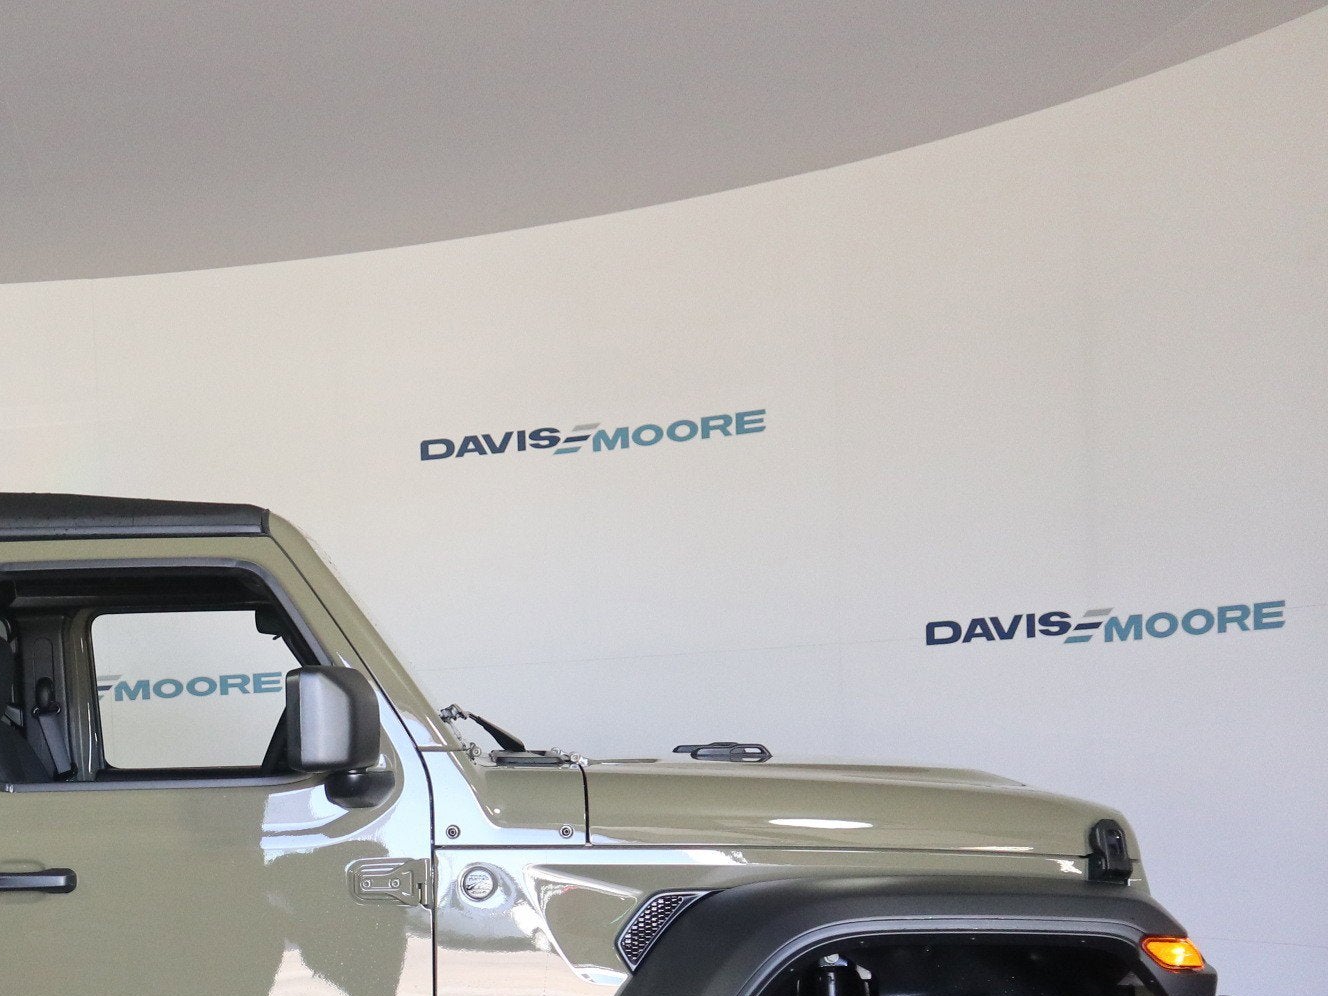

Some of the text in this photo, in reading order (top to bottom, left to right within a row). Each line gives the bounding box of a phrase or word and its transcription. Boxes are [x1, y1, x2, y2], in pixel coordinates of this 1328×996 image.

[420, 409, 767, 461] DAVIS MOORE
[925, 600, 1286, 646] DAVIS MOORE
[114, 672, 283, 701] MOORE
